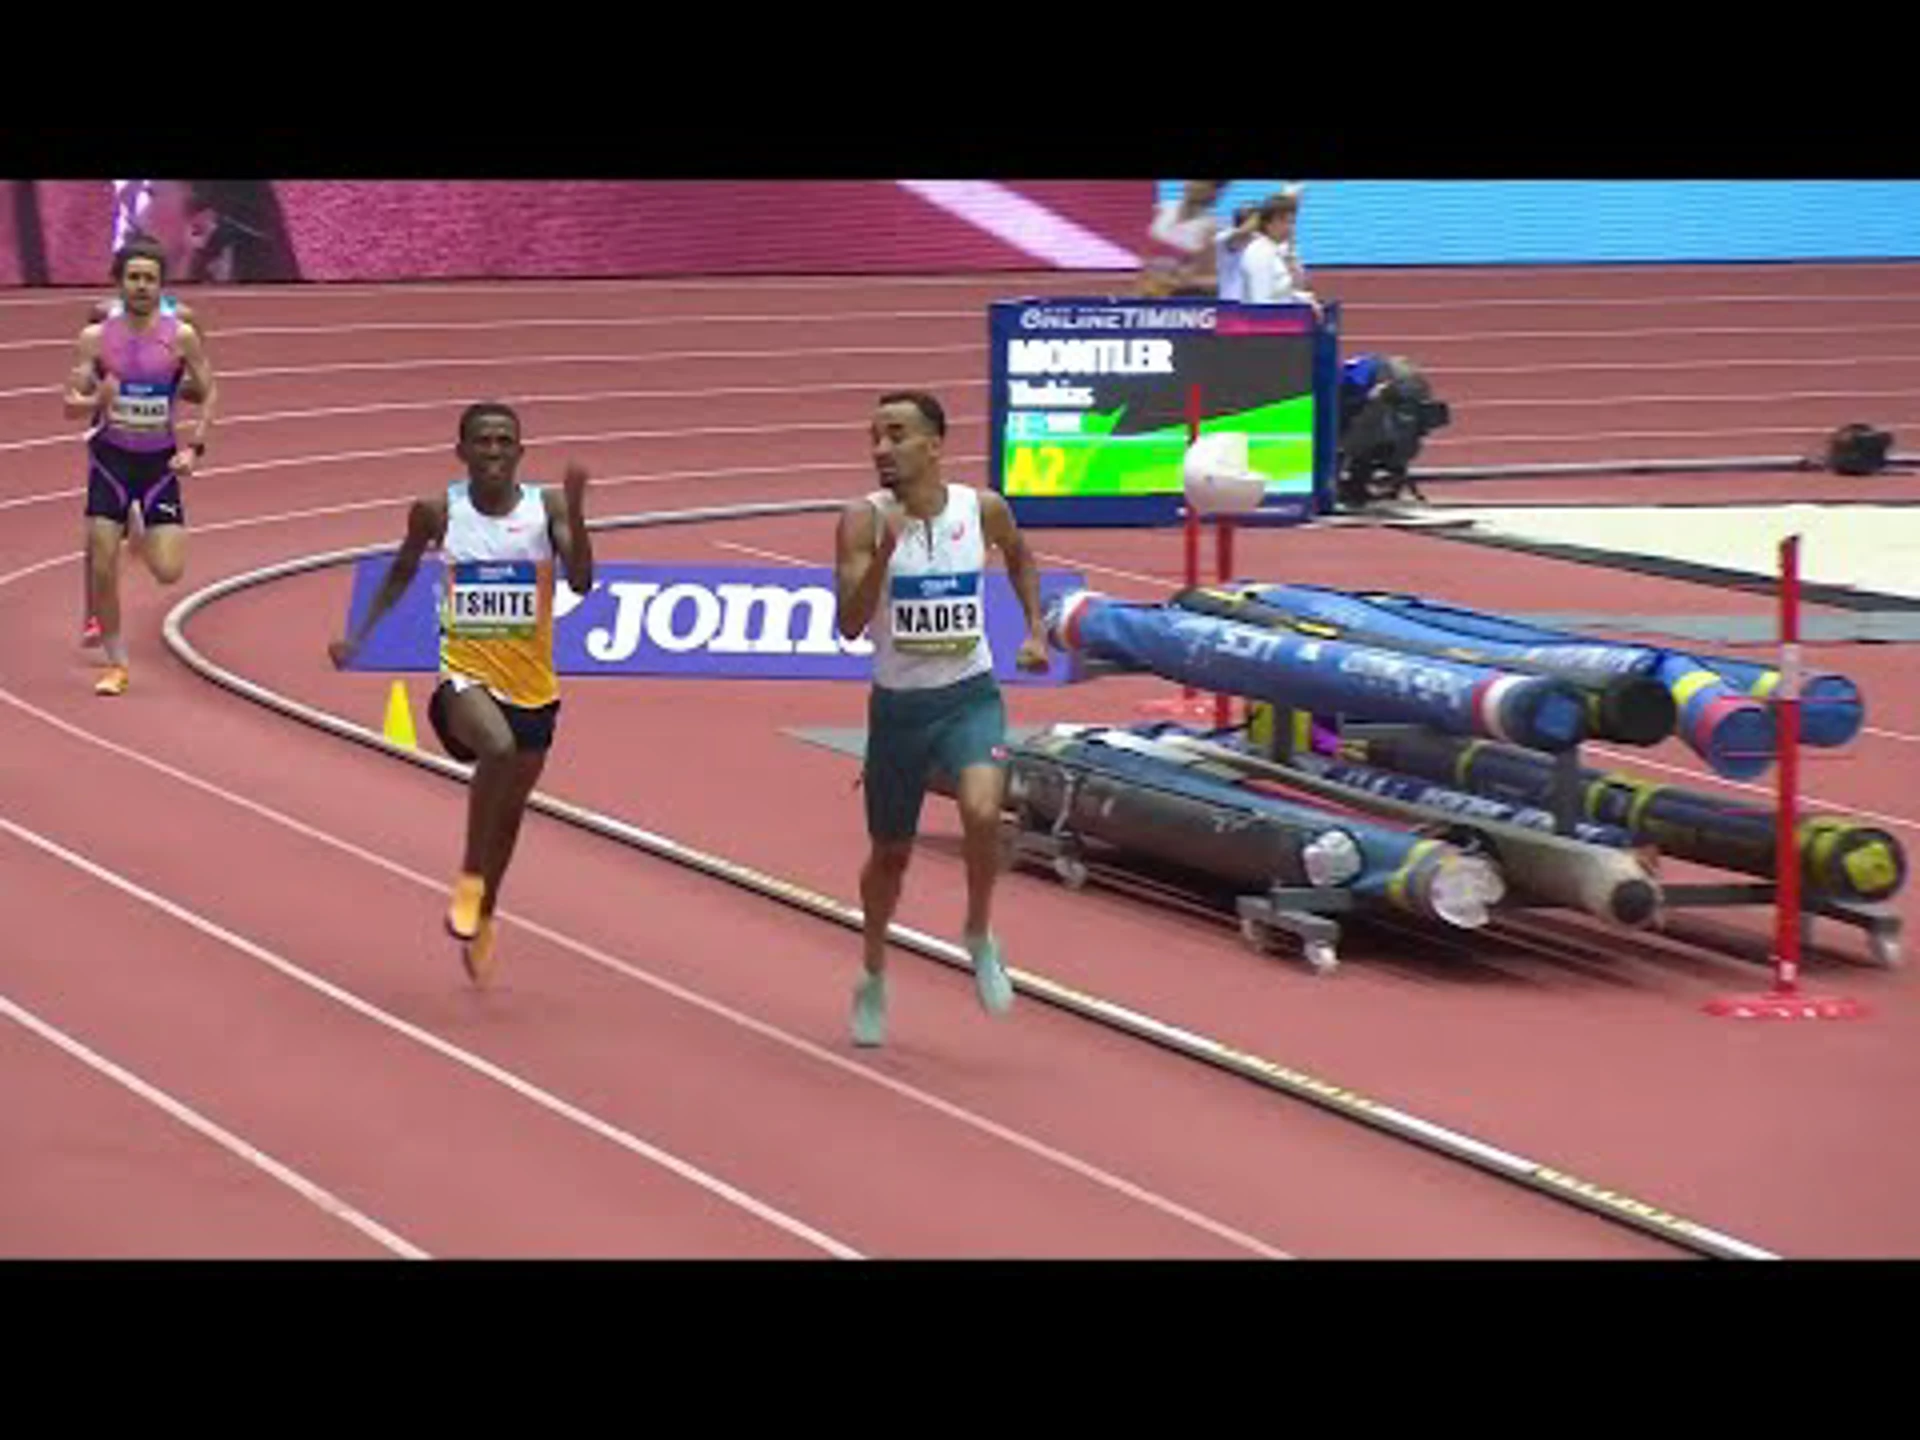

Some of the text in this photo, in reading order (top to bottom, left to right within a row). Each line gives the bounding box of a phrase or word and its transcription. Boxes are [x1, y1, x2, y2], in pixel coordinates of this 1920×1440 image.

[1007, 339, 1174, 373] MONTLER
[456, 591, 534, 617] TSHITE
[895, 603, 977, 633] NADER
